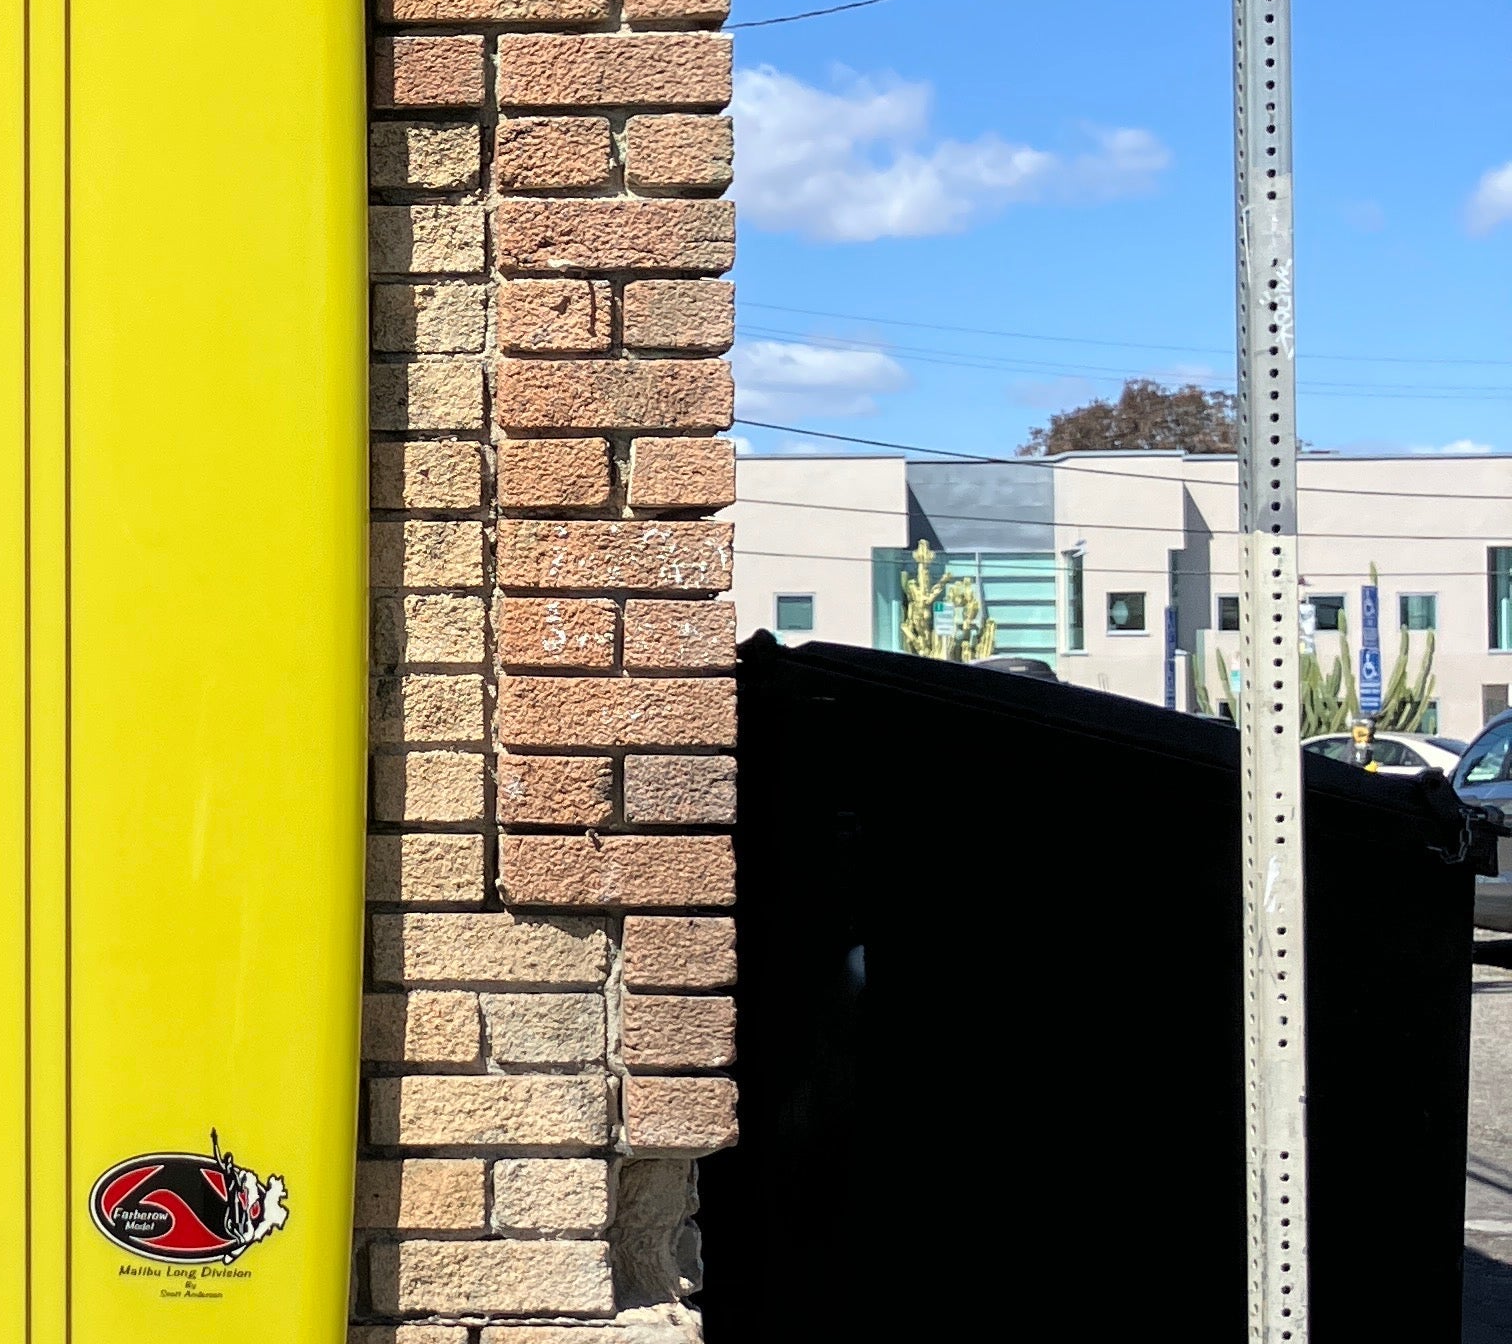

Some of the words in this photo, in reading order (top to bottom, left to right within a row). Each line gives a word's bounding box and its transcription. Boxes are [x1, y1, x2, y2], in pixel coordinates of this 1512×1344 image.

[125, 1220, 155, 1231] Model
[119, 1265, 161, 1277] Malibu
[166, 1265, 197, 1280] Long
[201, 1266, 252, 1278] Division
